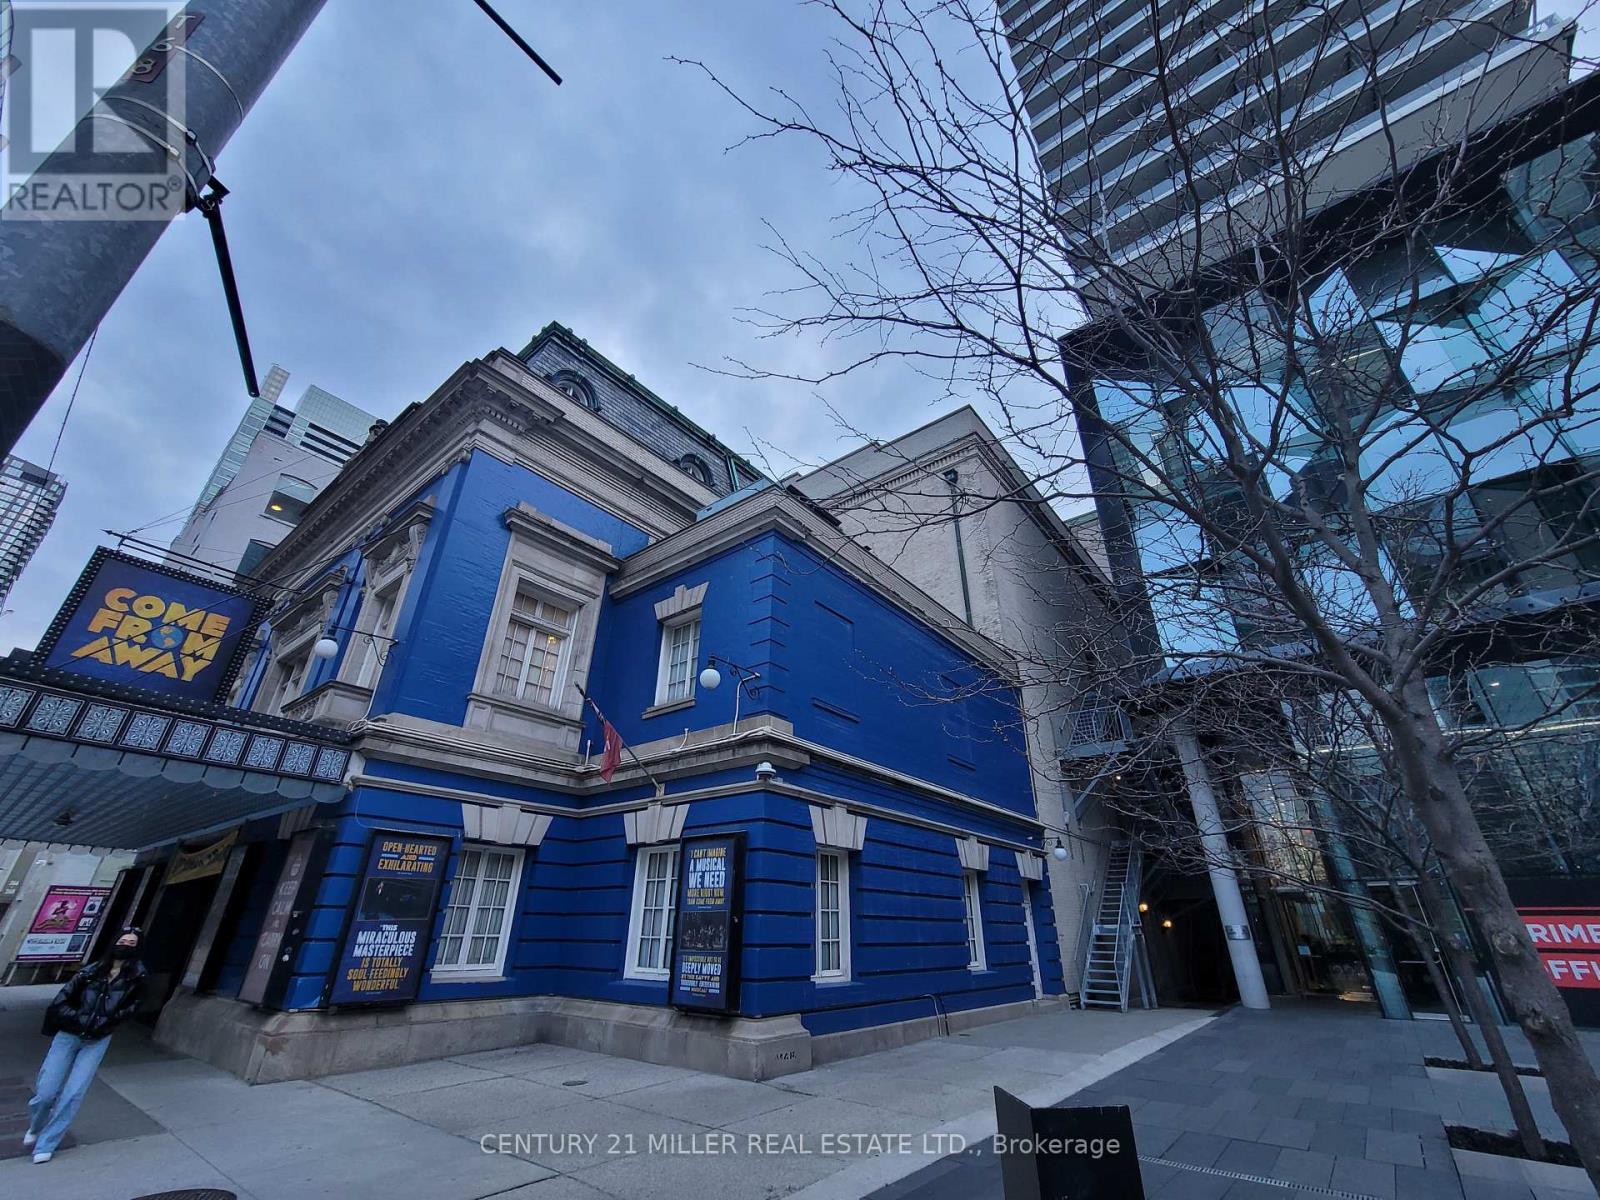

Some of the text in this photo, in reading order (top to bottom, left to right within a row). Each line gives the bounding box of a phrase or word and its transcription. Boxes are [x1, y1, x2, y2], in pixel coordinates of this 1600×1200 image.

[104, 587, 231, 637] COME
[71, 637, 212, 682] AWAY
[382, 842, 437, 855] OPEN-HEARTED
[377, 859, 434, 873] EXHILARATING
[689, 857, 726, 871] A MUSICAL
[689, 871, 726, 888] WE NEED
[357, 931, 417, 944] MIRACULOUS
[1525, 923, 1600, 944] RIME
[353, 944, 415, 957] MASTERPIECE
[360, 957, 403, 968] IS TOTALLY
[682, 962, 722, 975] DEEPLY MOVED
[1544, 959, 1600, 981] FFI
